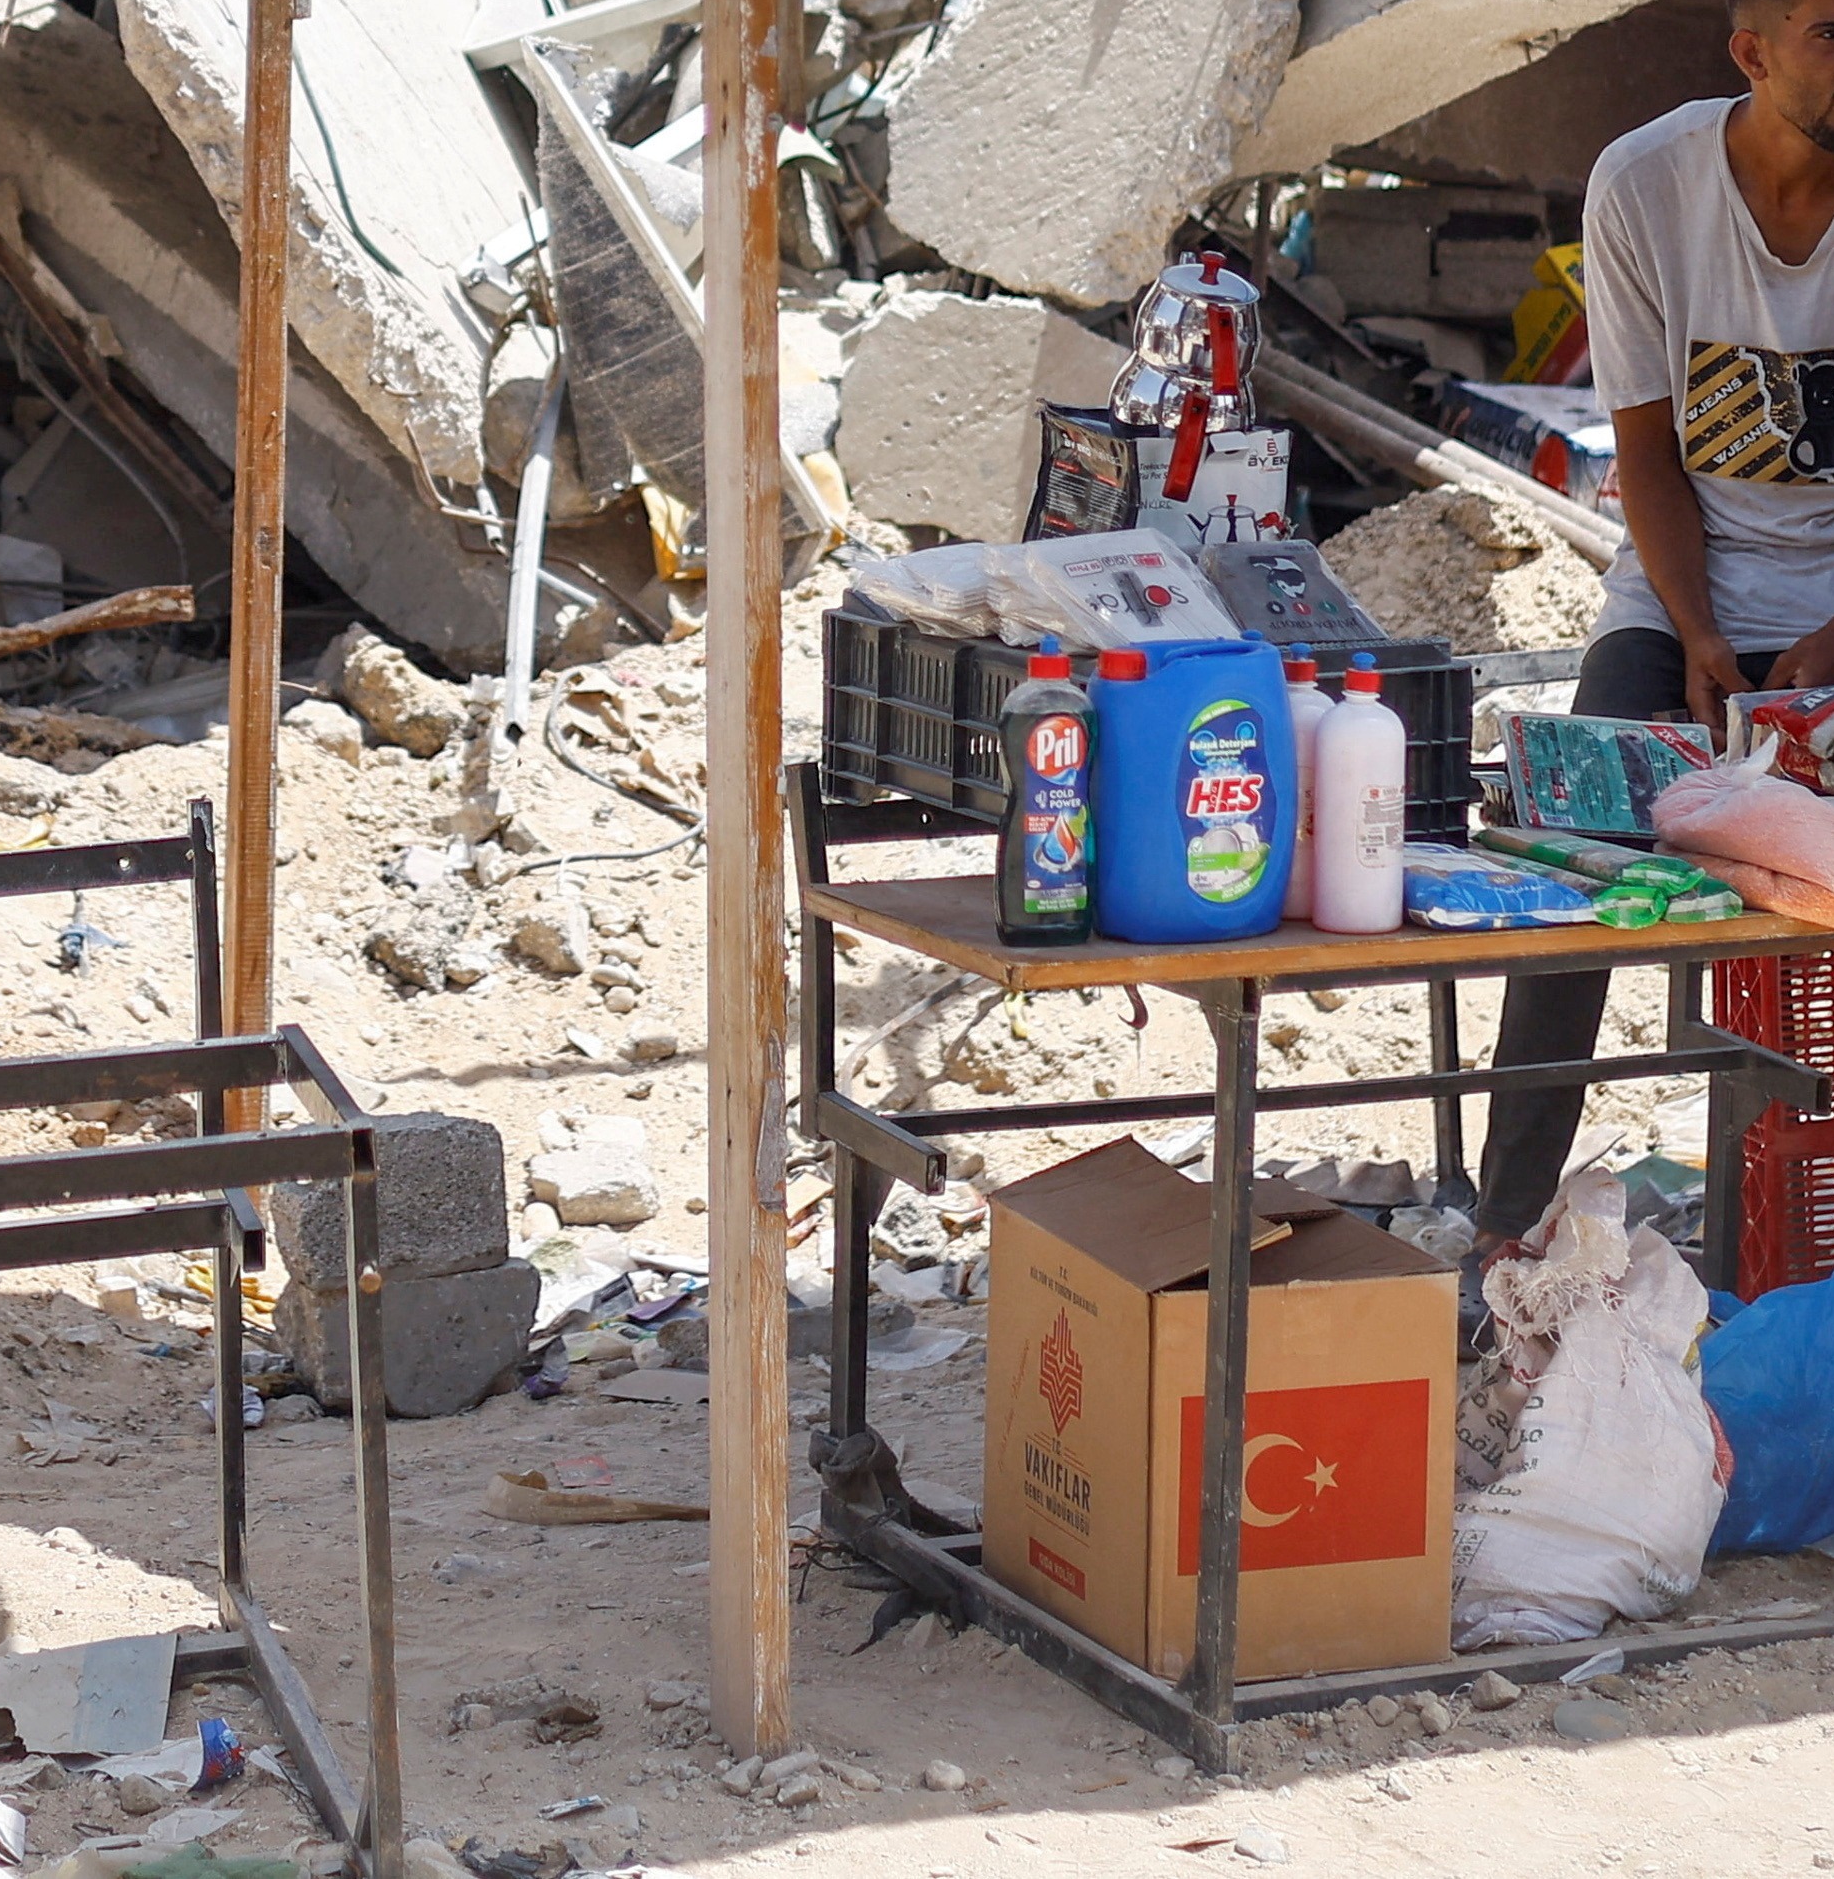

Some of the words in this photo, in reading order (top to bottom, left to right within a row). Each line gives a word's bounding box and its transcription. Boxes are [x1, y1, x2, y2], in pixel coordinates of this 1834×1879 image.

[1036, 726, 1078, 771] Pril
[1049, 789, 1074, 798] COLD
[1049, 797, 1081, 809] POWER
[1188, 775, 1262, 816] HES
[1025, 1441, 1091, 1513] VAKIFLAR
